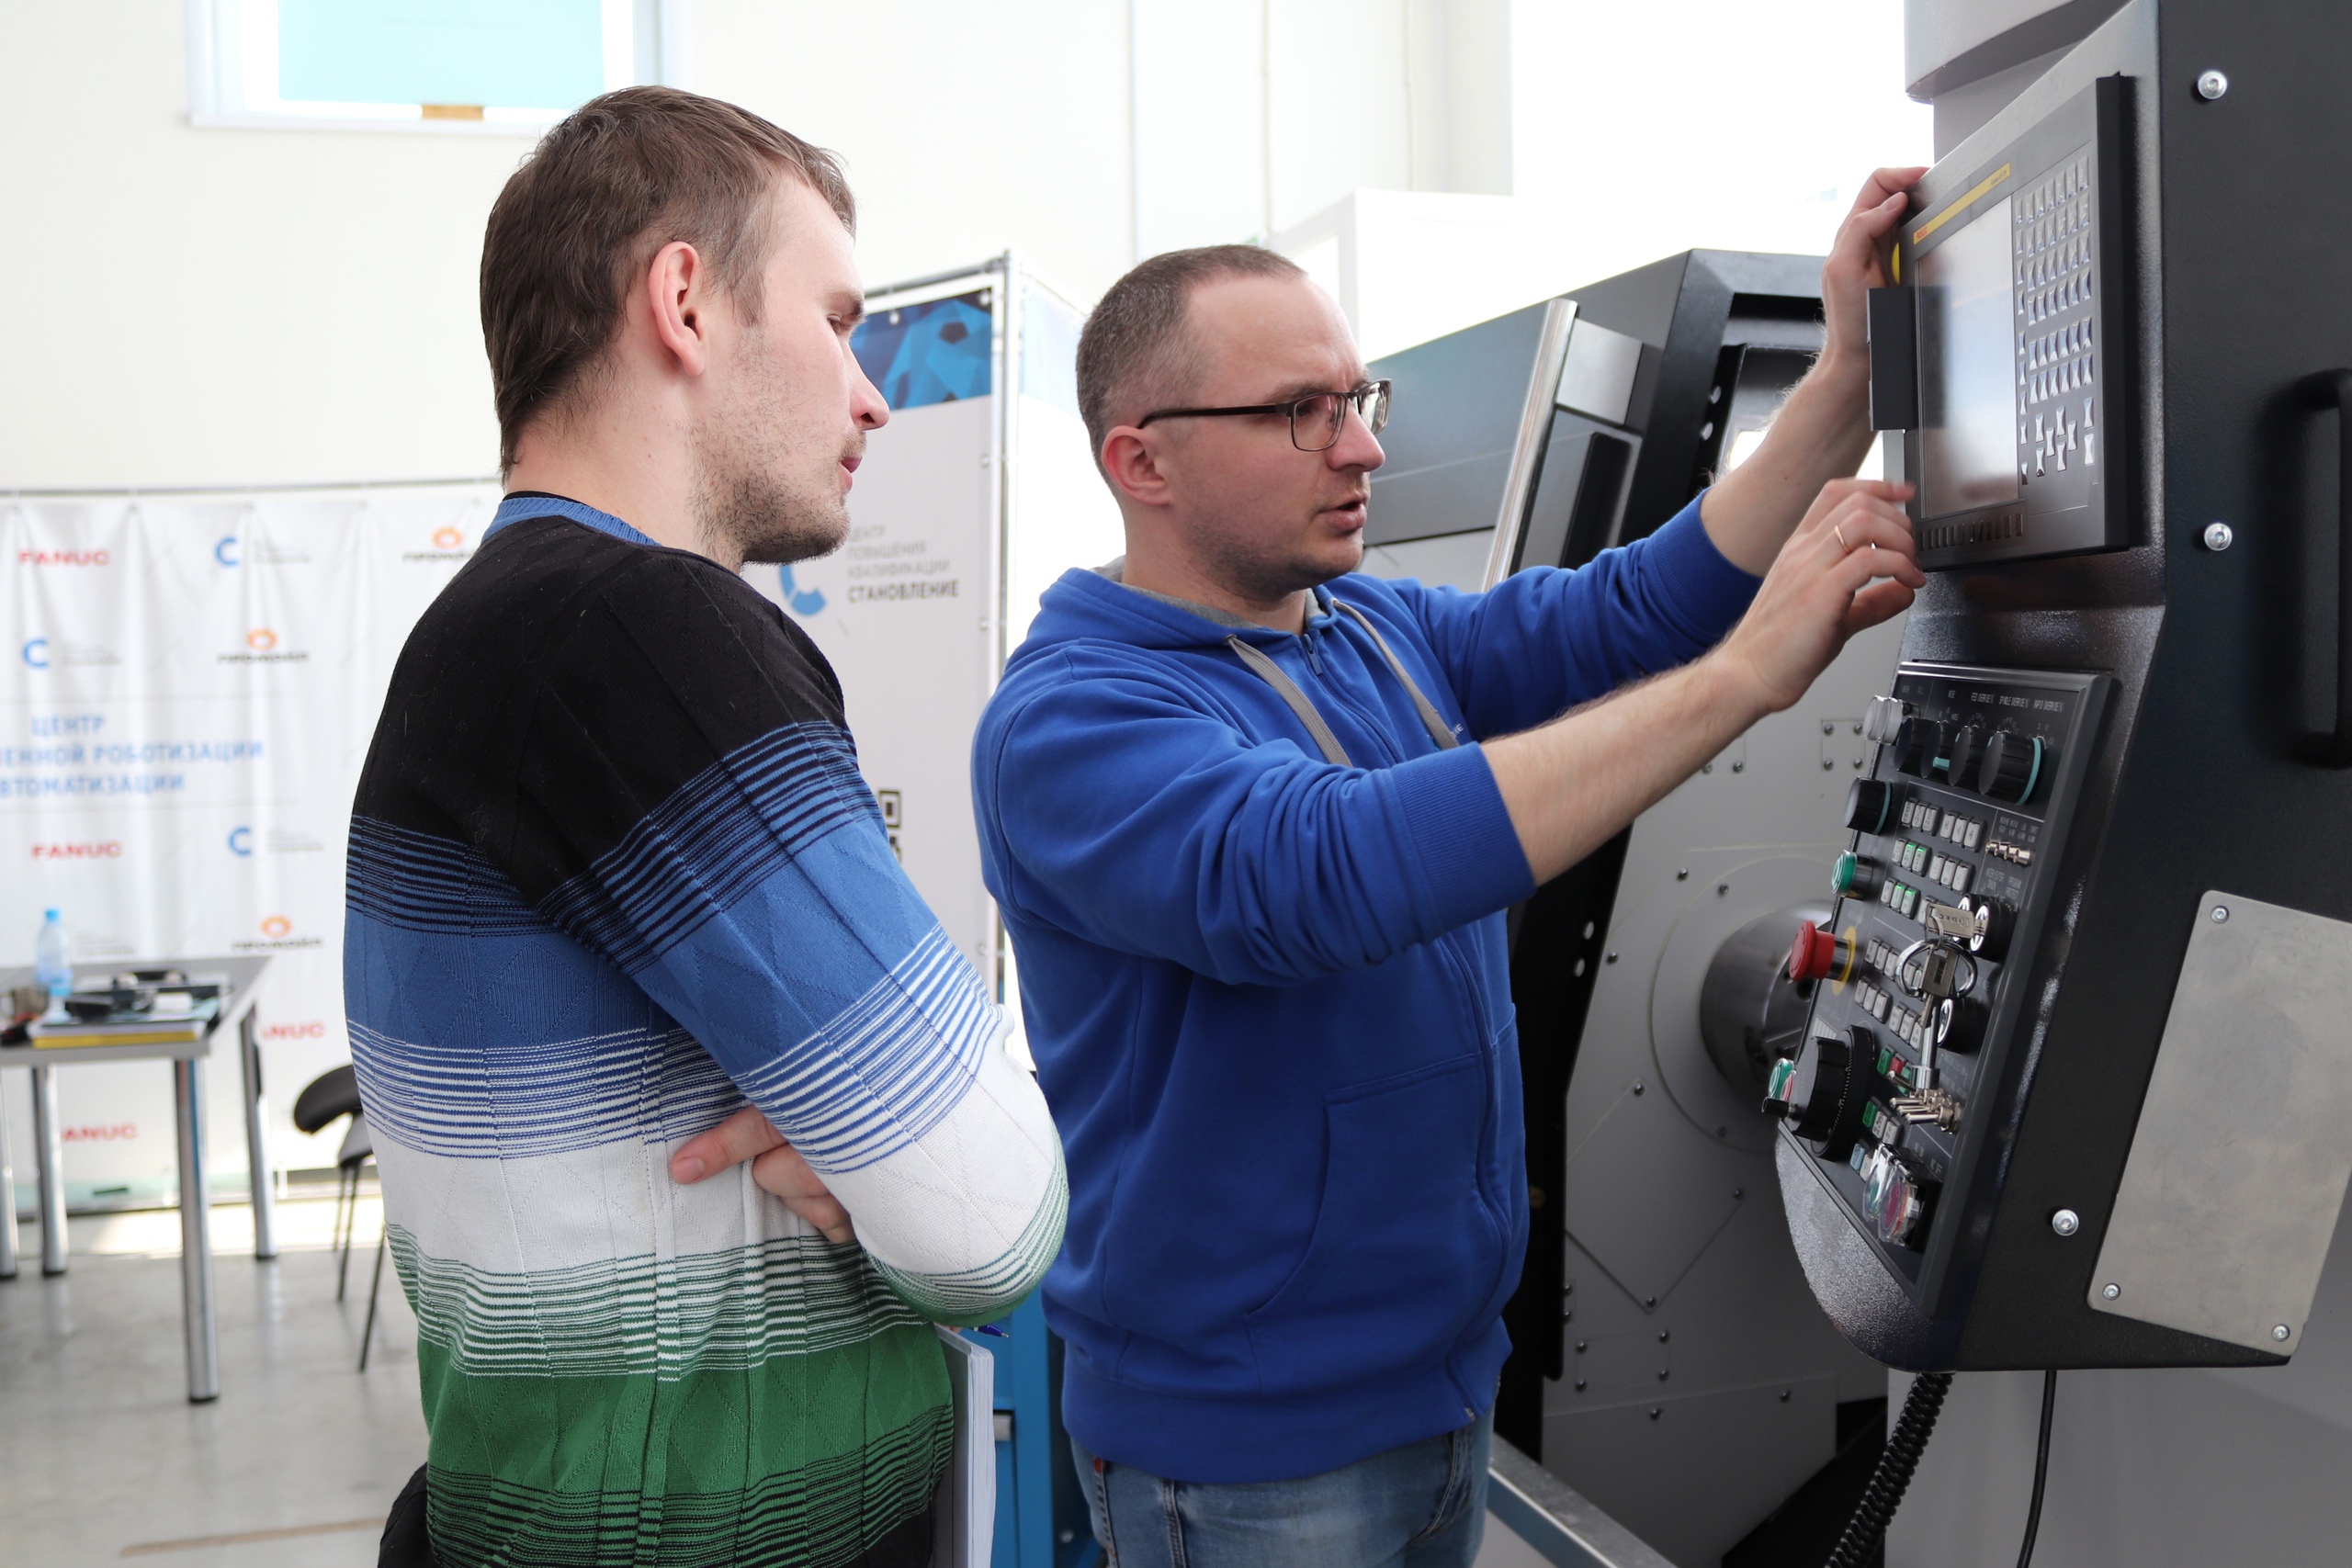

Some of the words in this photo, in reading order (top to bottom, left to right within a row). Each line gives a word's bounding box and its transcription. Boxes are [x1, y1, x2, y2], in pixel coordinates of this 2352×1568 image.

[18, 549, 110, 567] FANUC
[847, 579, 960, 603] СТАНОВЛЕНИЕ
[30, 715, 106, 737] ЦЕНТР
[0, 745, 85, 768] ЕННОЙ
[93, 741, 264, 766] РОБОТИЗАЦИИ
[31, 841, 122, 860] FANUC
[262, 1021, 325, 1041] NUC
[60, 1122, 138, 1143] ANUC
